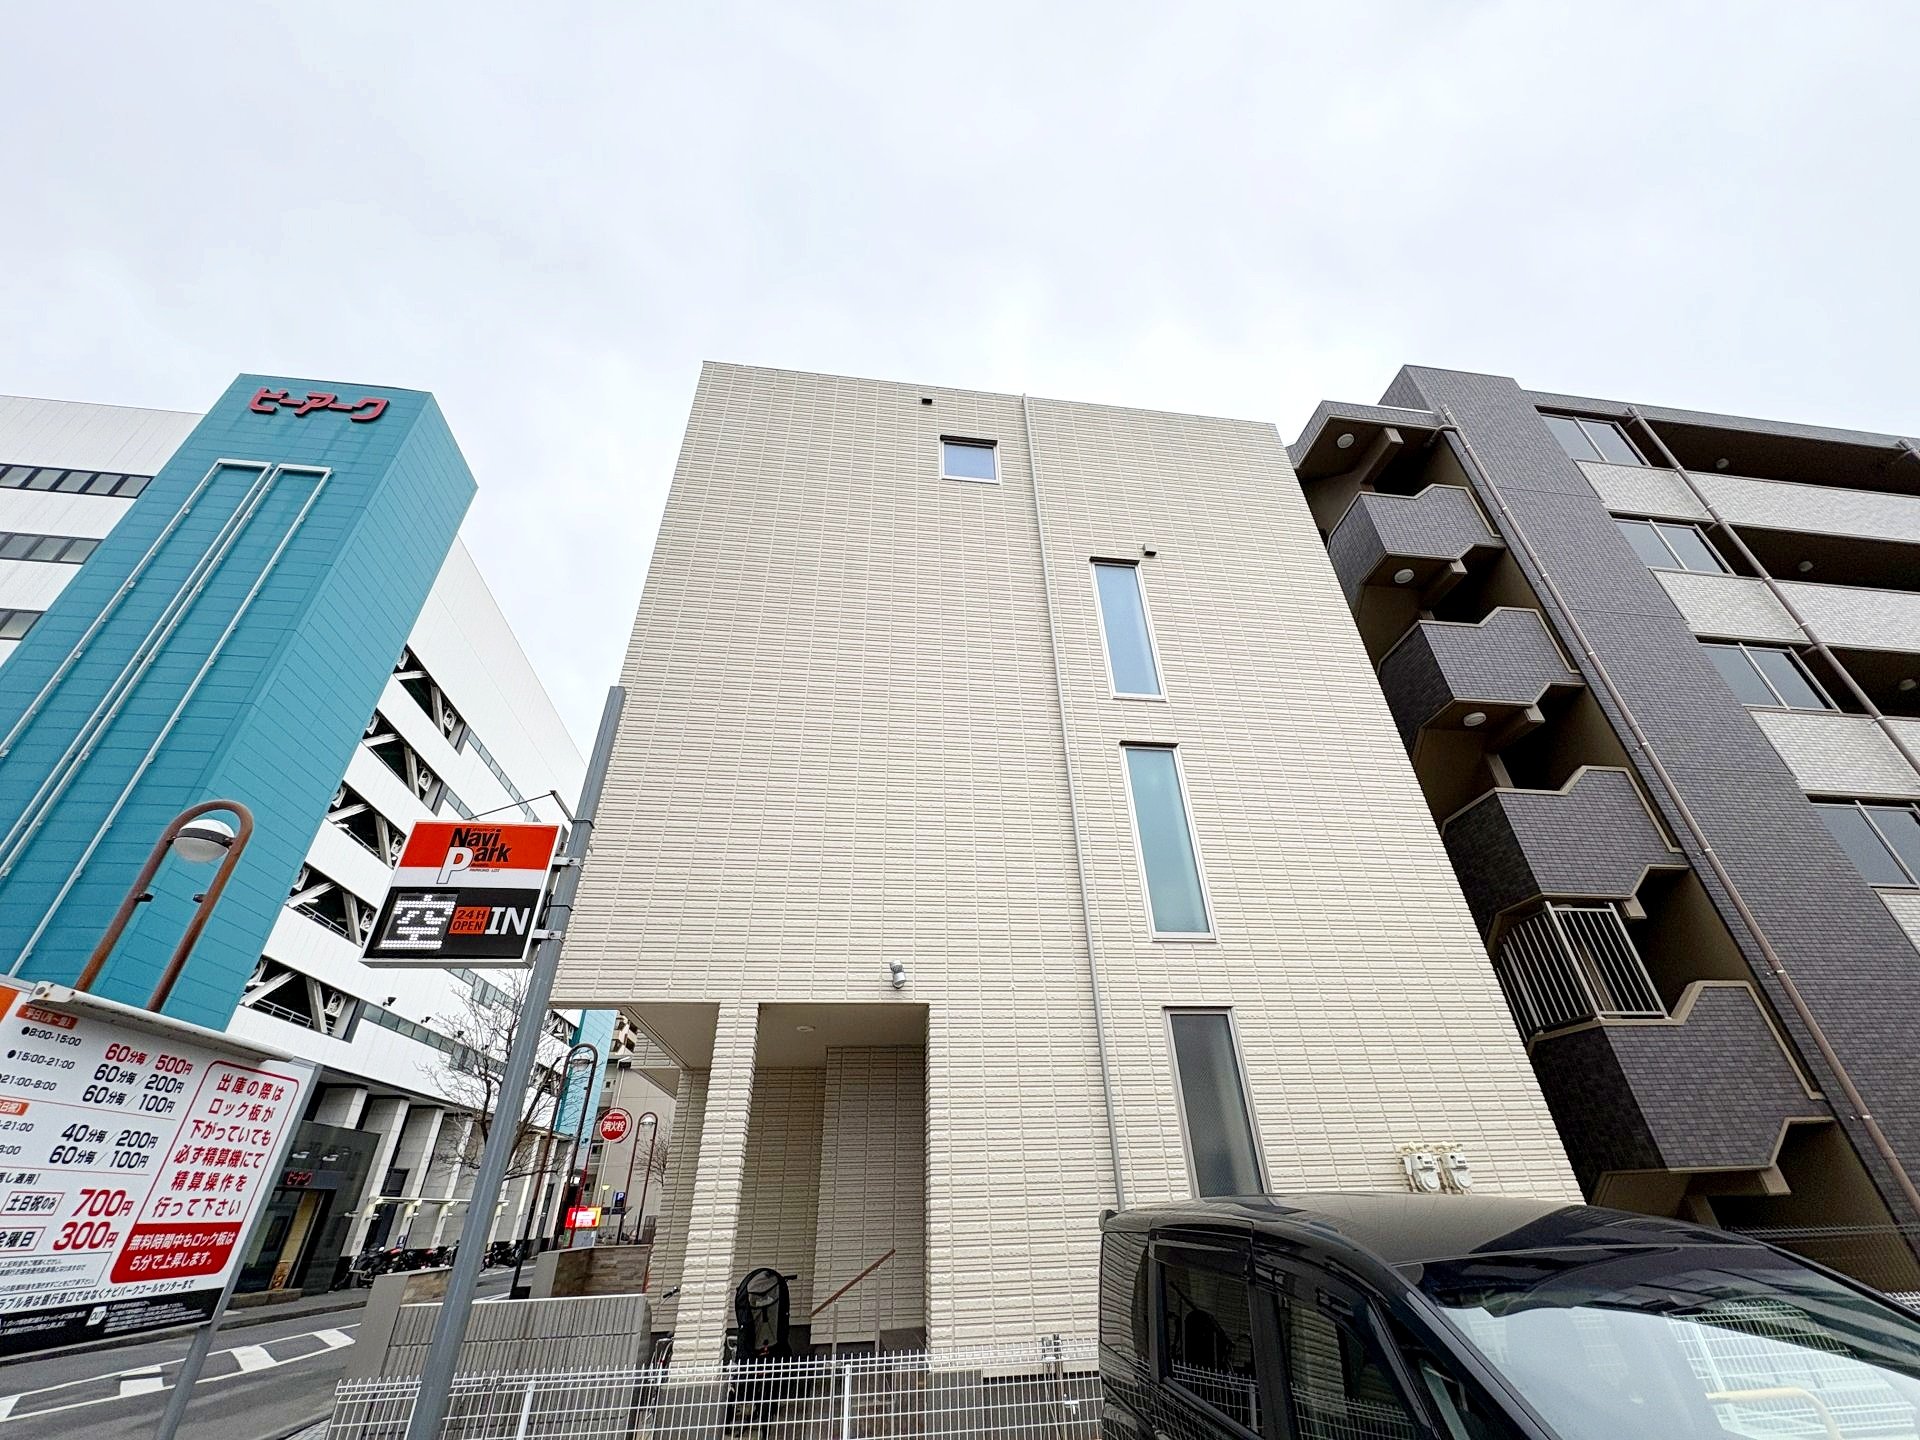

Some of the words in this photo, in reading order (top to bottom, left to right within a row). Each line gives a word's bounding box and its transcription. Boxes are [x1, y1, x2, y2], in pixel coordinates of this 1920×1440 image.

[449, 827, 502, 847] Navi
[435, 843, 512, 884] Park
[379, 894, 457, 950] 空
[452, 920, 484, 932] OPEN
[456, 910, 486, 920] 24H
[484, 906, 531, 936] IN
[215, 1073, 285, 1102] 出庫の際は
[207, 1098, 276, 1123] ロック板が
[0, 1120, 34, 1133] -21:00
[189, 1118, 272, 1147] 下がっていても
[602, 1120, 625, 1132] 消火栓
[173, 1144, 266, 1169] 必ず精算機にて
[170, 1170, 248, 1193] 精算操作を
[71, 1188, 135, 1217] 700円
[151, 1196, 242, 1218] 行って下さい
[618, 1192, 626, 1201] P
[52, 1221, 120, 1251] 300円
[127, 1231, 236, 1251] 無料時間中もロック板は
[129, 1250, 213, 1272] 5分で上昇します。
